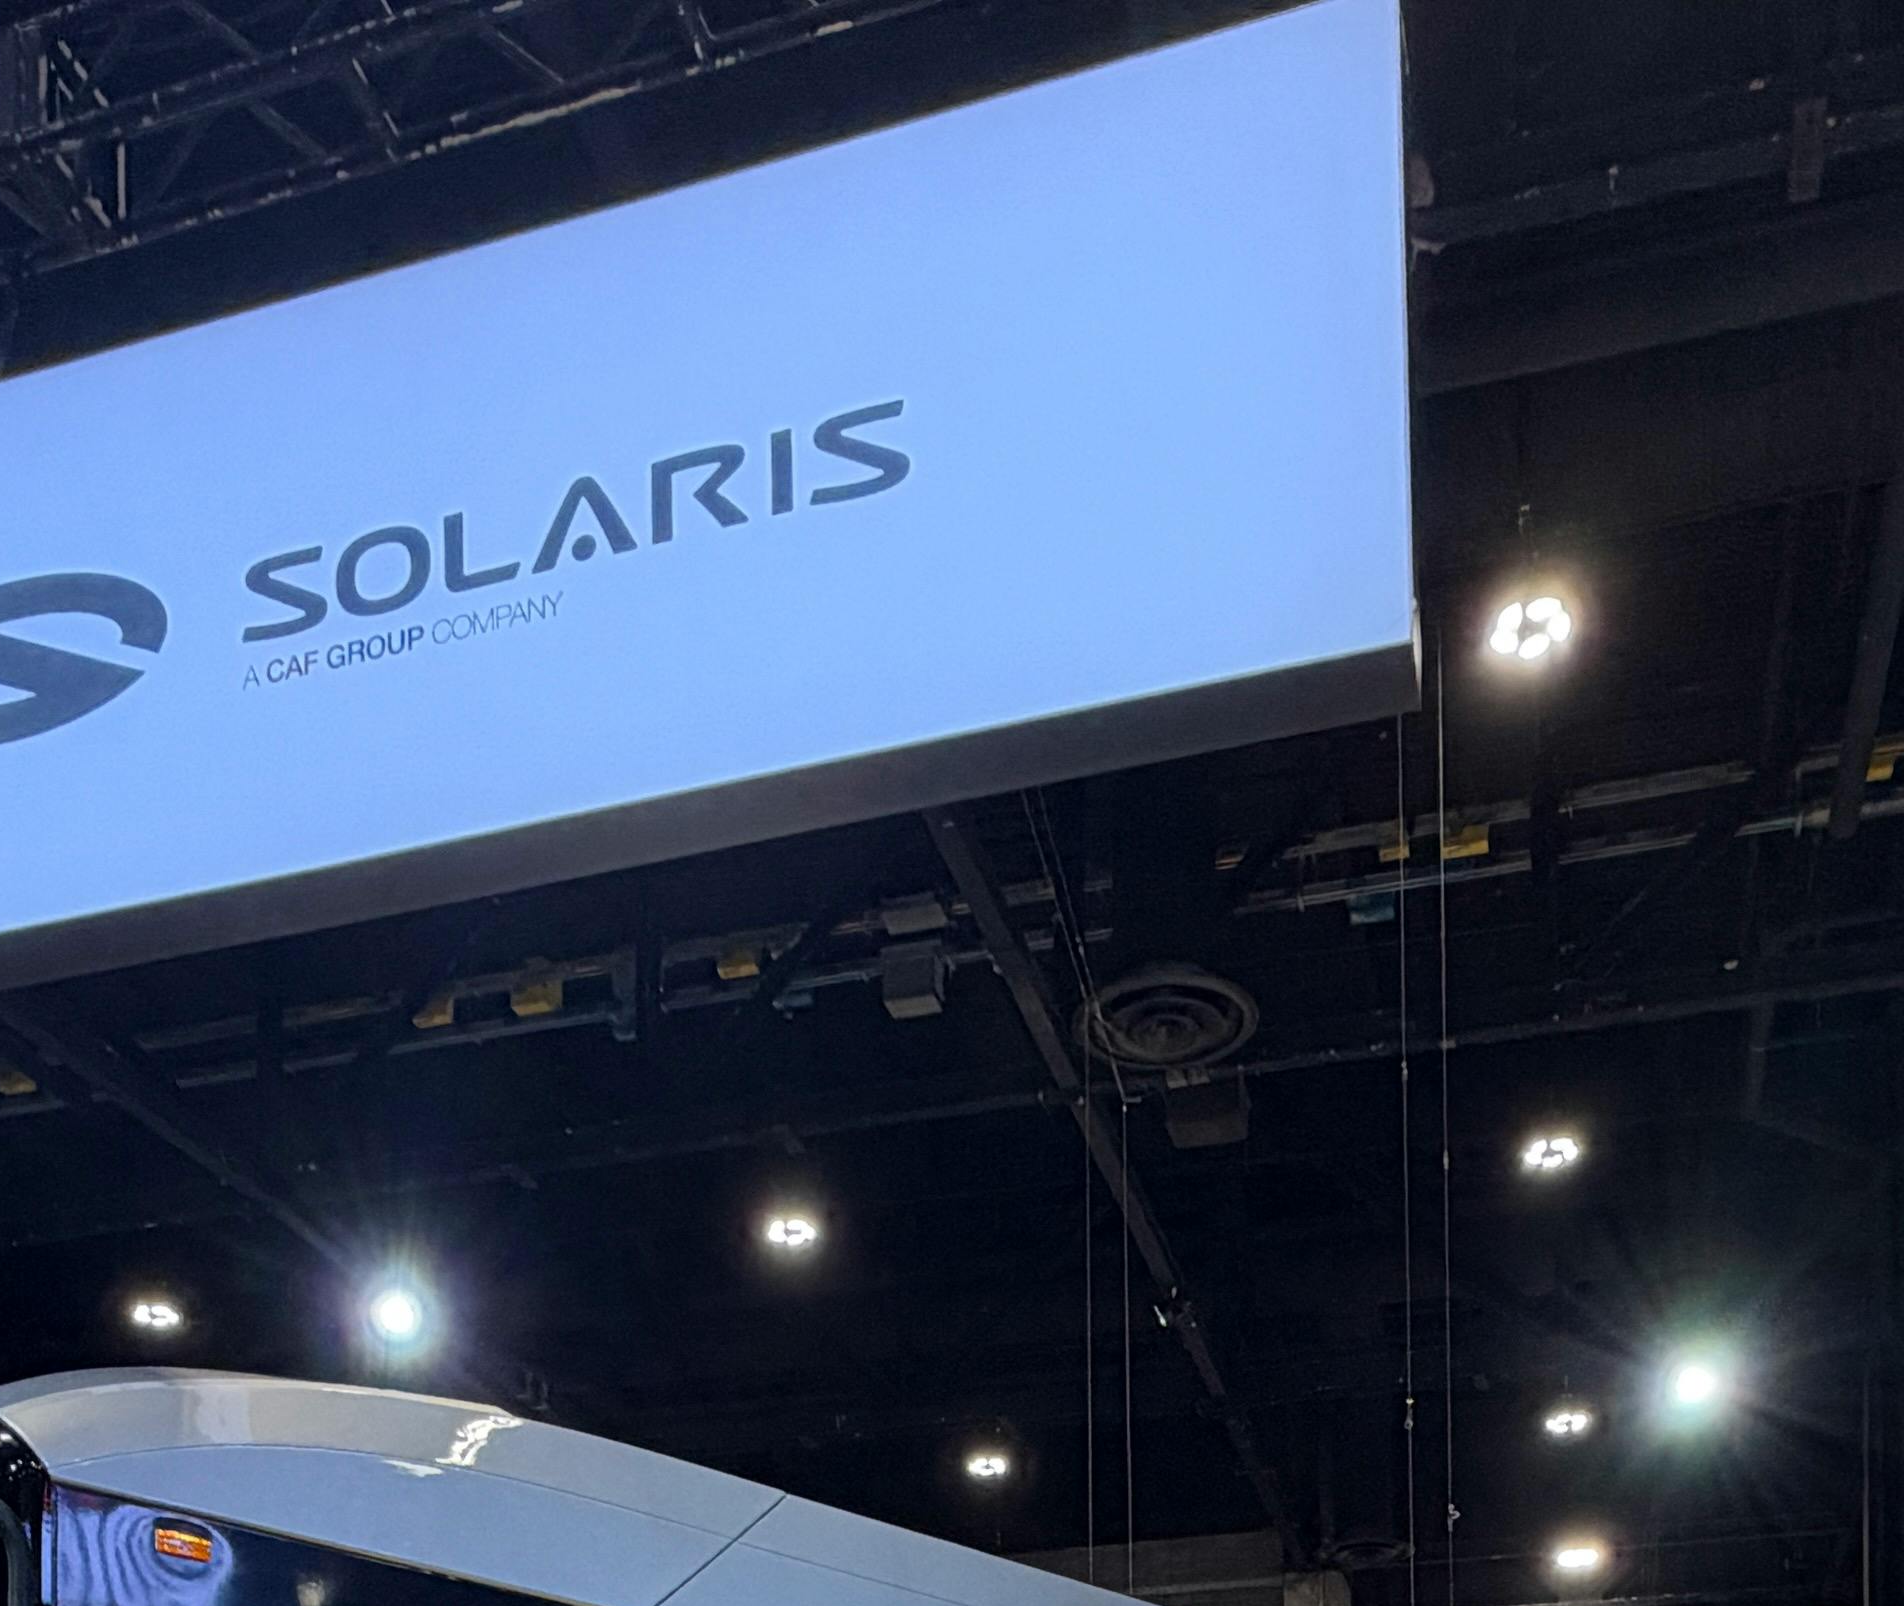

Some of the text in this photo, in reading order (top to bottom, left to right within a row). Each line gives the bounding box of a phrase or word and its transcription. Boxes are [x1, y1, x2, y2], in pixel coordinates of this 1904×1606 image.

[241, 399, 911, 643] SOLARIS
[242, 590, 564, 691] A CAF GROUP COMPANY
